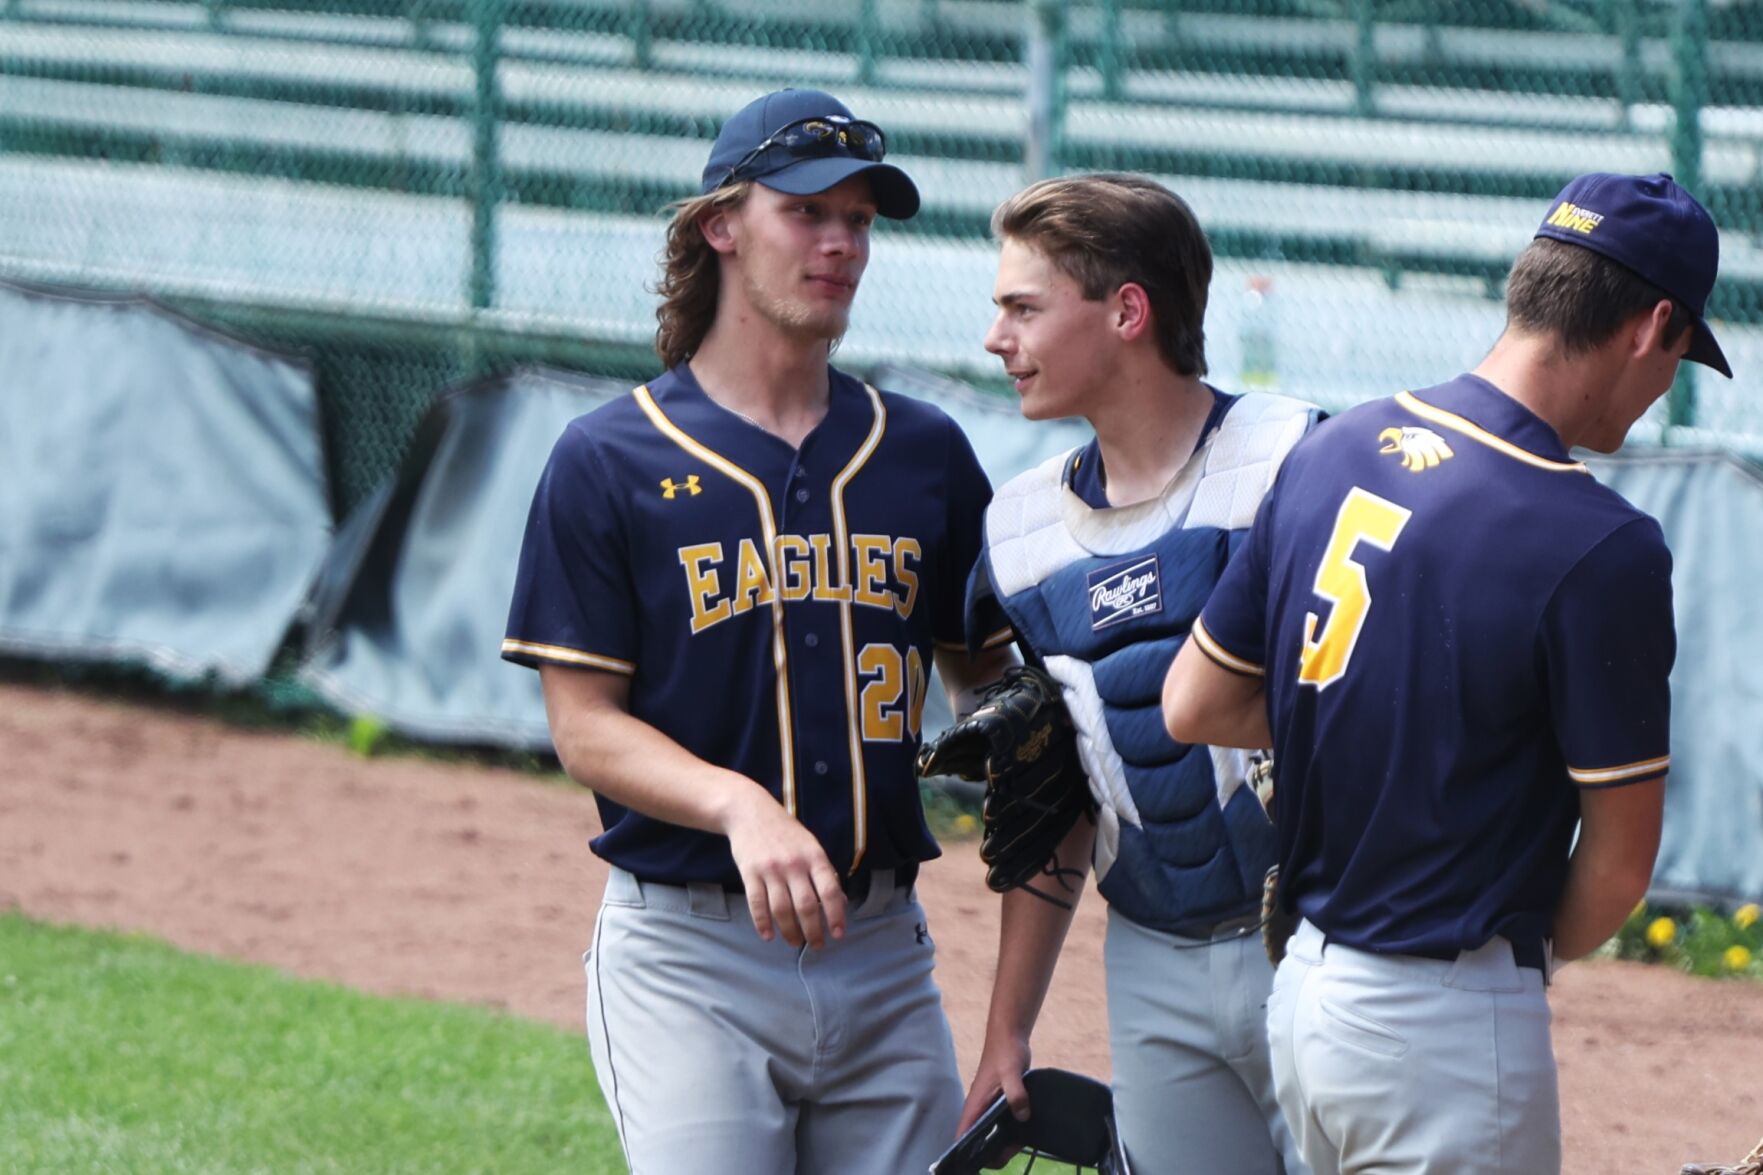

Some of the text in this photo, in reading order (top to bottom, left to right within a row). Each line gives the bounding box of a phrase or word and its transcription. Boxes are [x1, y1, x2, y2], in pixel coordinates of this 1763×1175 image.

[678, 534, 922, 635] EAGLES
[1092, 571, 1156, 612] Rawlings
[1298, 486, 1412, 692] 5
[857, 643, 925, 743] 20
